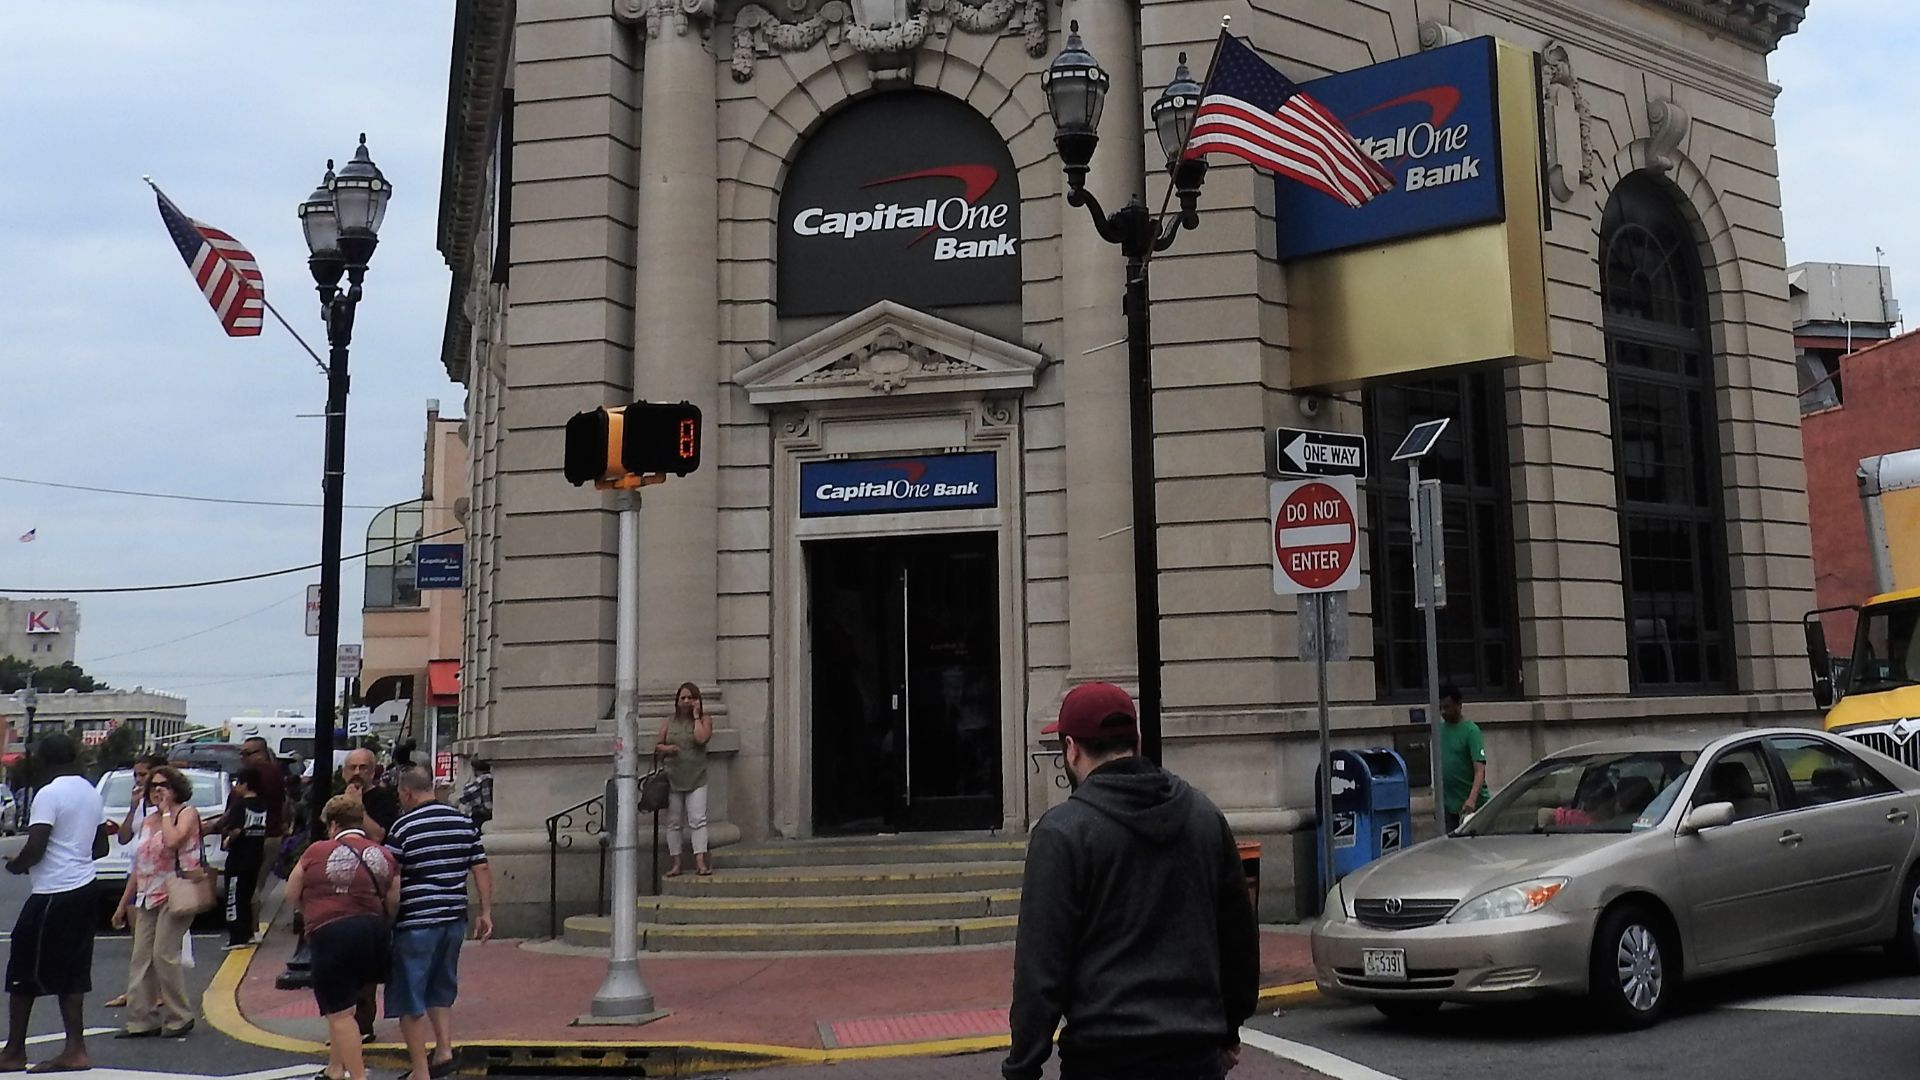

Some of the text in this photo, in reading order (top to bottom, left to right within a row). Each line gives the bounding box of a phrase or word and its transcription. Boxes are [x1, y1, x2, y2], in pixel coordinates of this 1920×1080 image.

[1405, 156, 1480, 192] Bank
[933, 233, 1018, 261] Bank
[1303, 444, 1357, 465] ONE WAY
[933, 481, 979, 497] Bank
[1286, 500, 1341, 522] DO NOT
[1292, 550, 1340, 572] ENTER
[349, 721, 369, 734] 25
